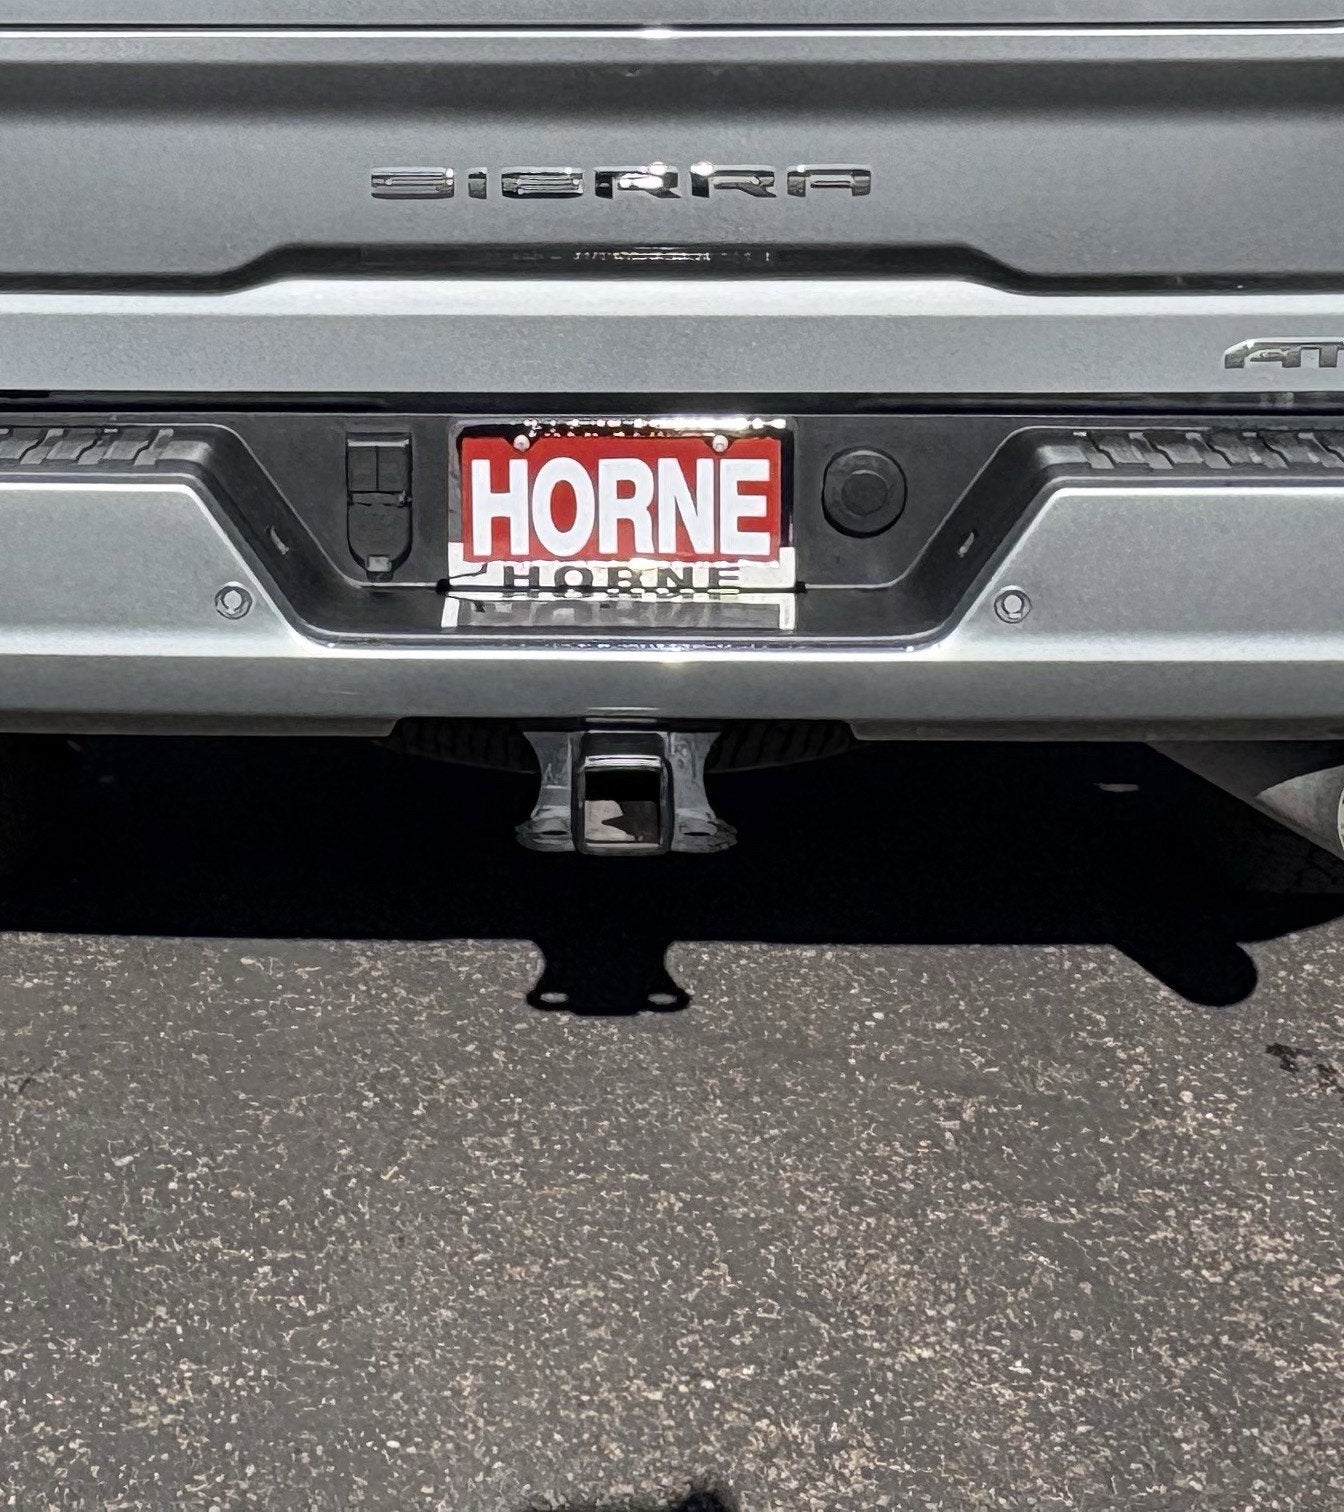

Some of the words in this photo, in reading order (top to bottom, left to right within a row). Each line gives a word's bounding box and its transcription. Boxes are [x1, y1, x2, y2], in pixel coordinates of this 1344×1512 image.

[370, 162, 873, 199] SIERRA
[471, 456, 771, 557] HORNE
[503, 565, 741, 592] HORNE
